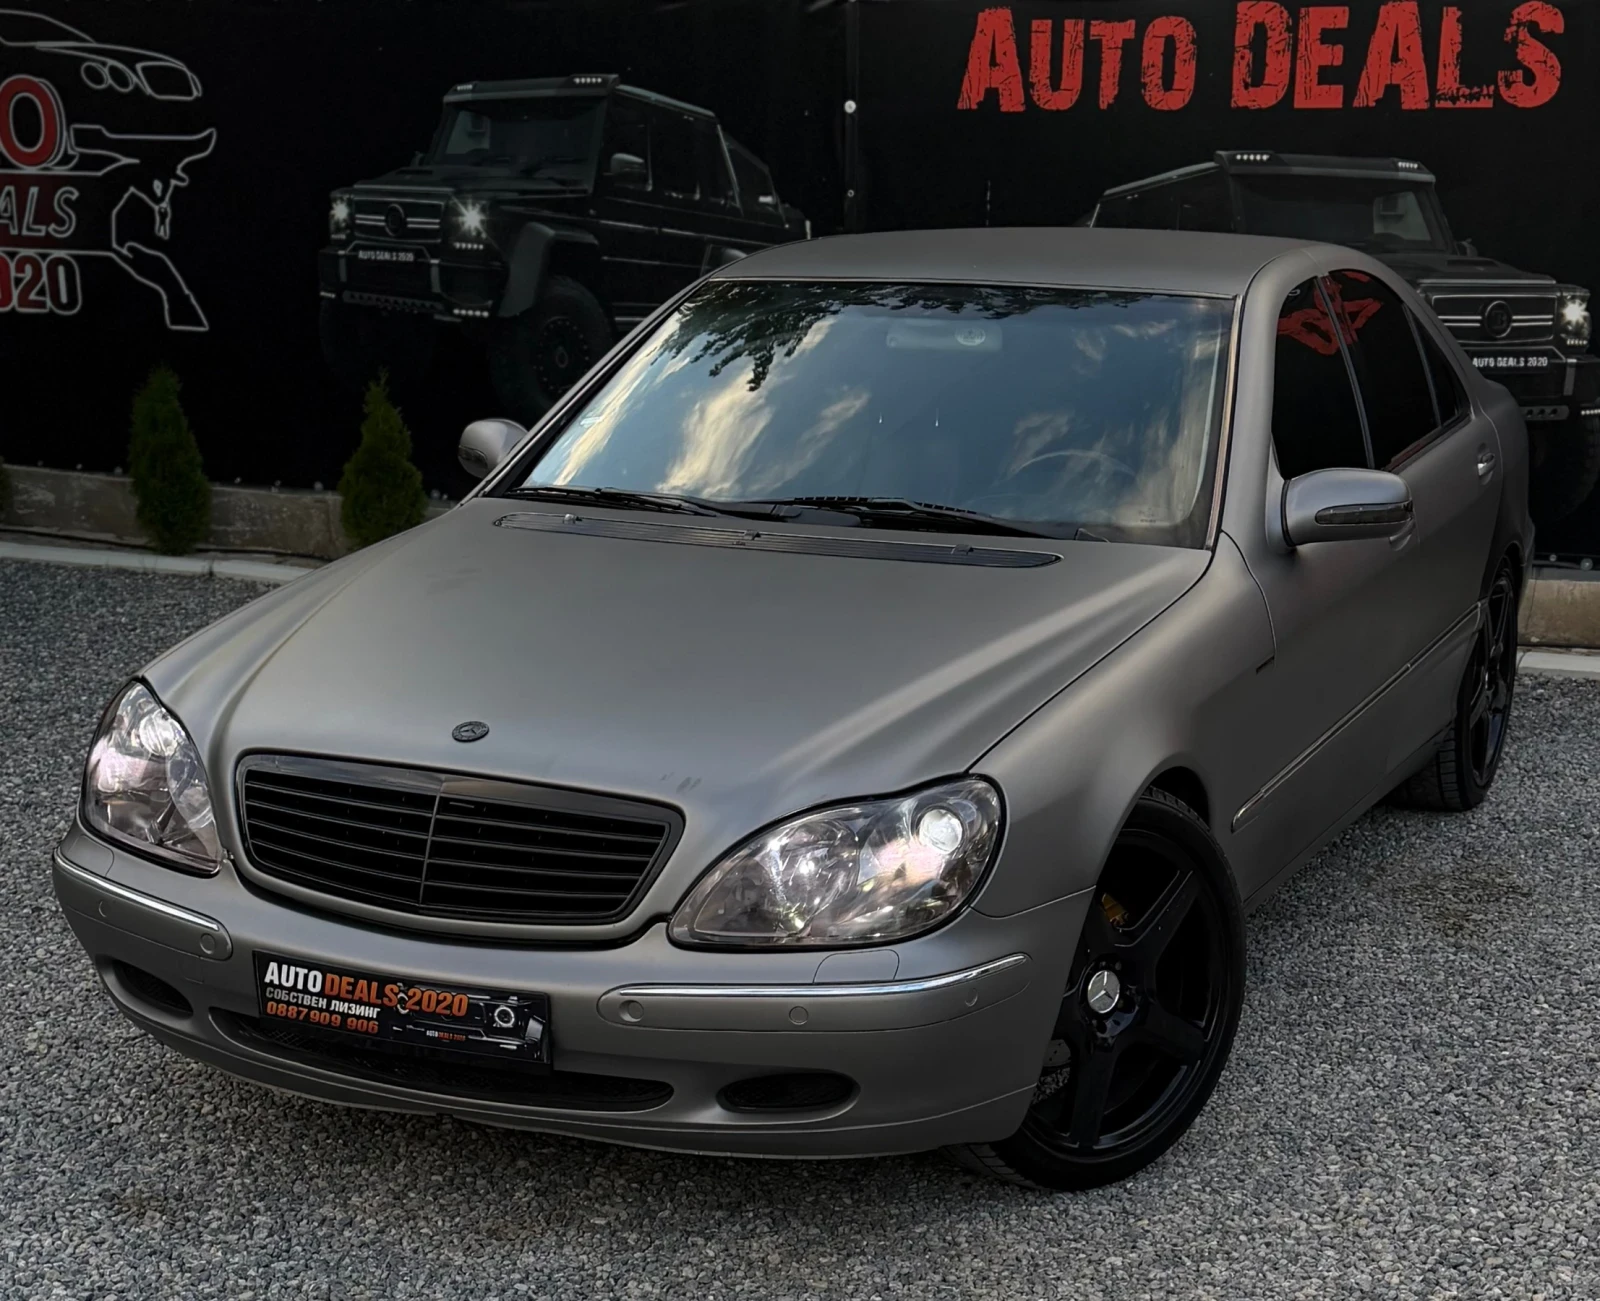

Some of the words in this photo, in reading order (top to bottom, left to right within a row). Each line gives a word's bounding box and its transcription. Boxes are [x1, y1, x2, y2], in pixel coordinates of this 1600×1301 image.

[957, 5, 1197, 112] AUTO
[1230, 0, 1566, 111] DEALS
[1472, 356, 1495, 367] AUTO
[1496, 356, 1525, 367] DEALS
[1526, 356, 1548, 367] 2020
[265, 987, 327, 1009] СОБСТВЕН
[329, 1000, 381, 1019] ЛИЗИНГ
[405, 987, 469, 1017] 2020
[346, 1017, 379, 1034] 906
